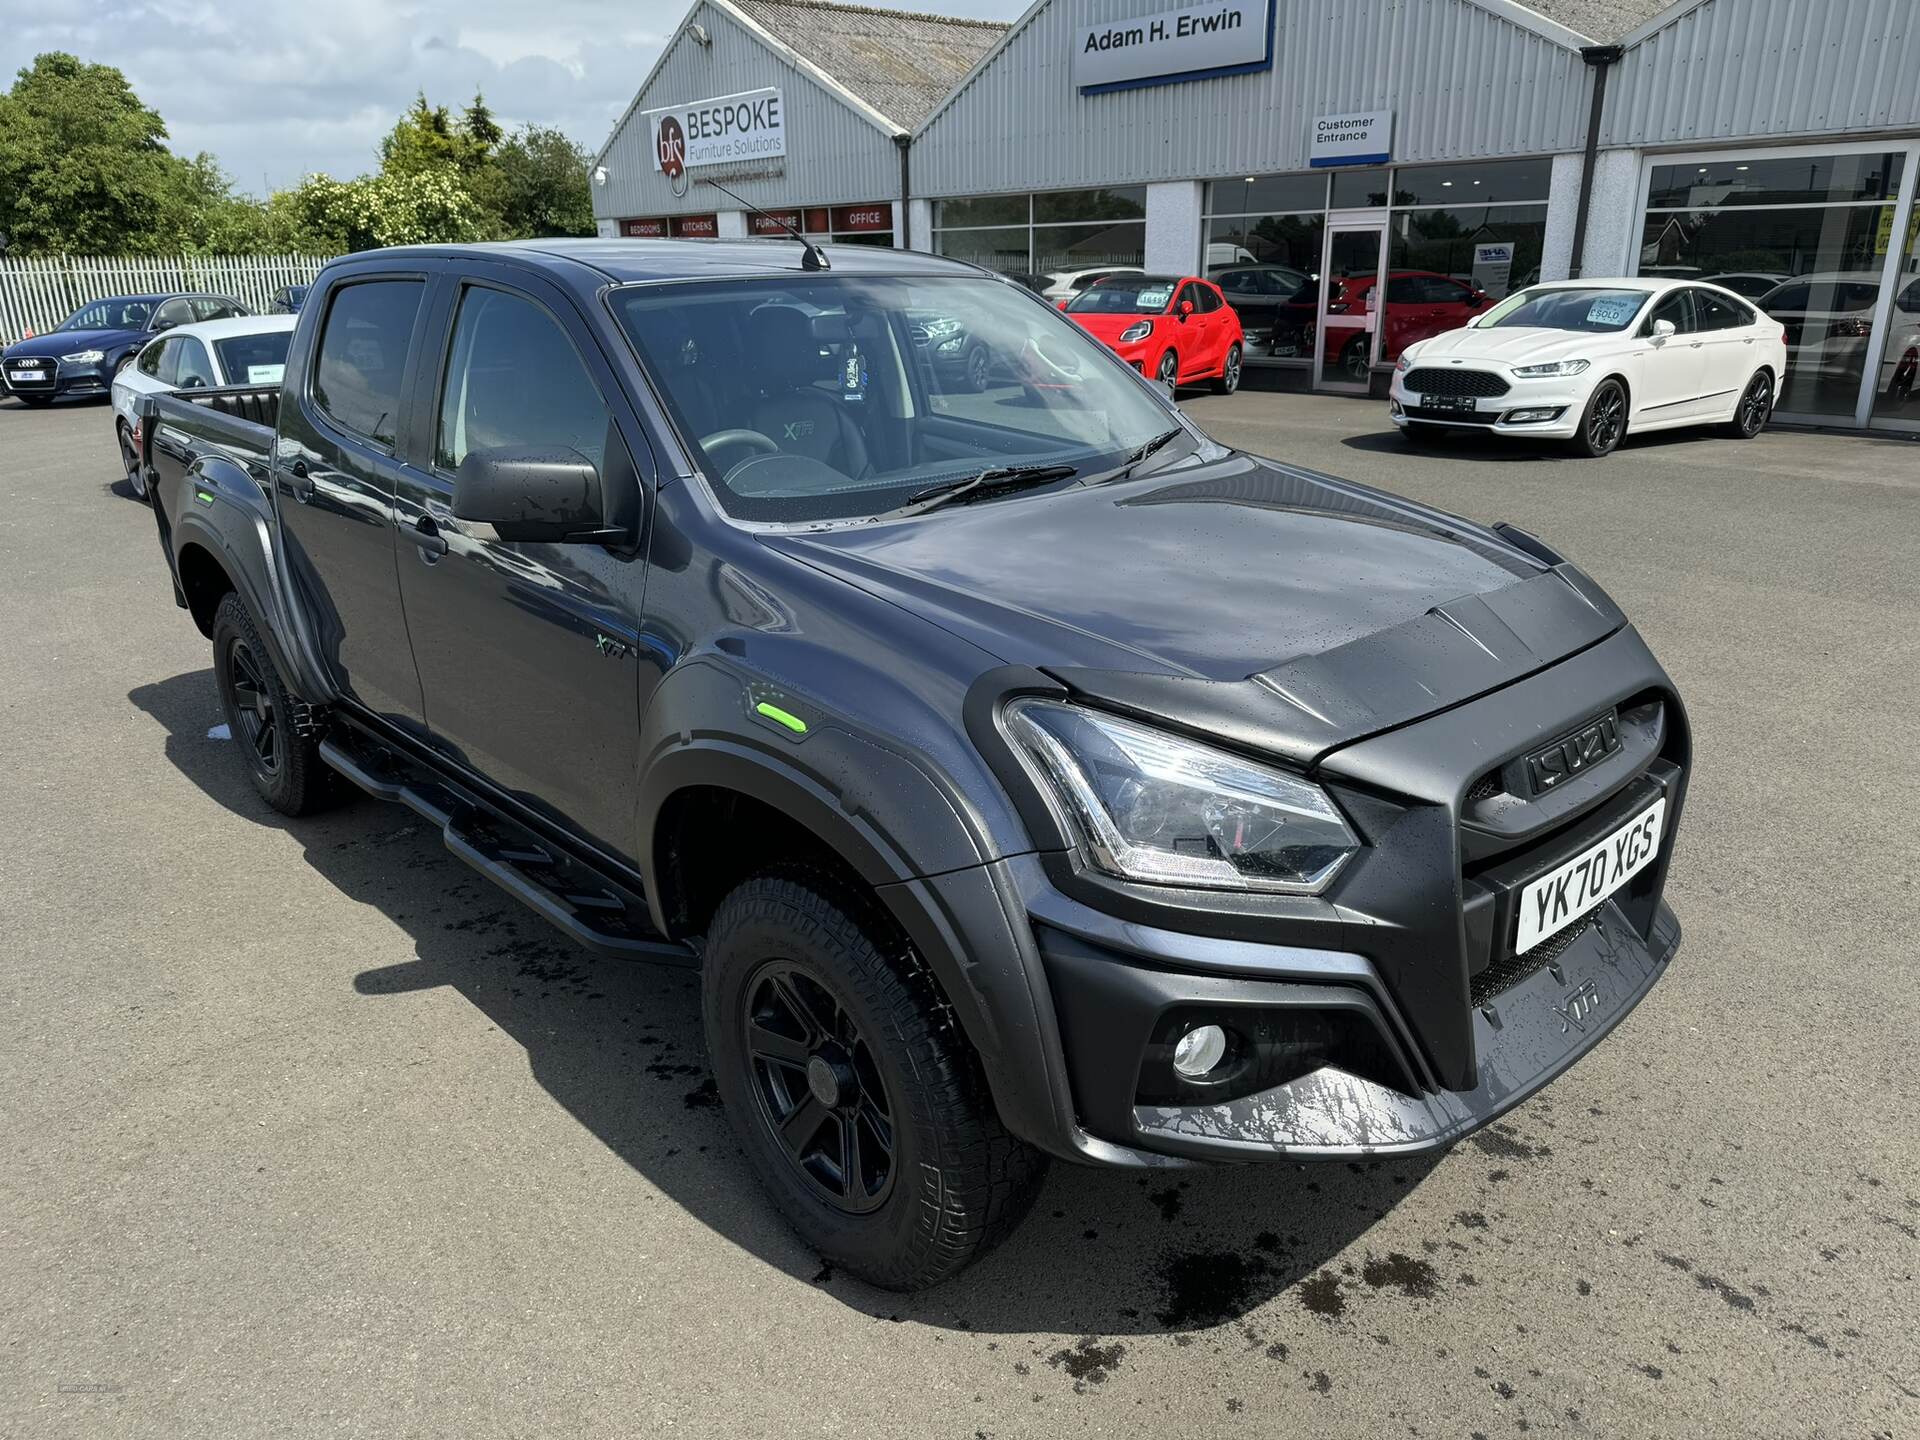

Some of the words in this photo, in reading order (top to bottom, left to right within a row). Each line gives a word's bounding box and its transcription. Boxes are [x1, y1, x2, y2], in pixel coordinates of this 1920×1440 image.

[1084, 29, 1143, 53] Adam
[1150, 20, 1170, 42] H.
[1176, 8, 1242, 38] Erwin
[687, 97, 780, 140] BESPOKE
[1317, 118, 1375, 131] Customer
[1316, 131, 1368, 143] Entrance
[689, 143, 732, 161] Furniture
[734, 136, 782, 156] Solutions
[756, 216, 797, 229] FURNITURE
[849, 211, 880, 225] OFFICE
[630, 223, 661, 235] BEDROOMS
[682, 221, 713, 232] KITCHENS
[1529, 716, 1618, 795] ISUZU
[1536, 848, 1608, 933] YK70
[1610, 813, 1656, 885] XGS
